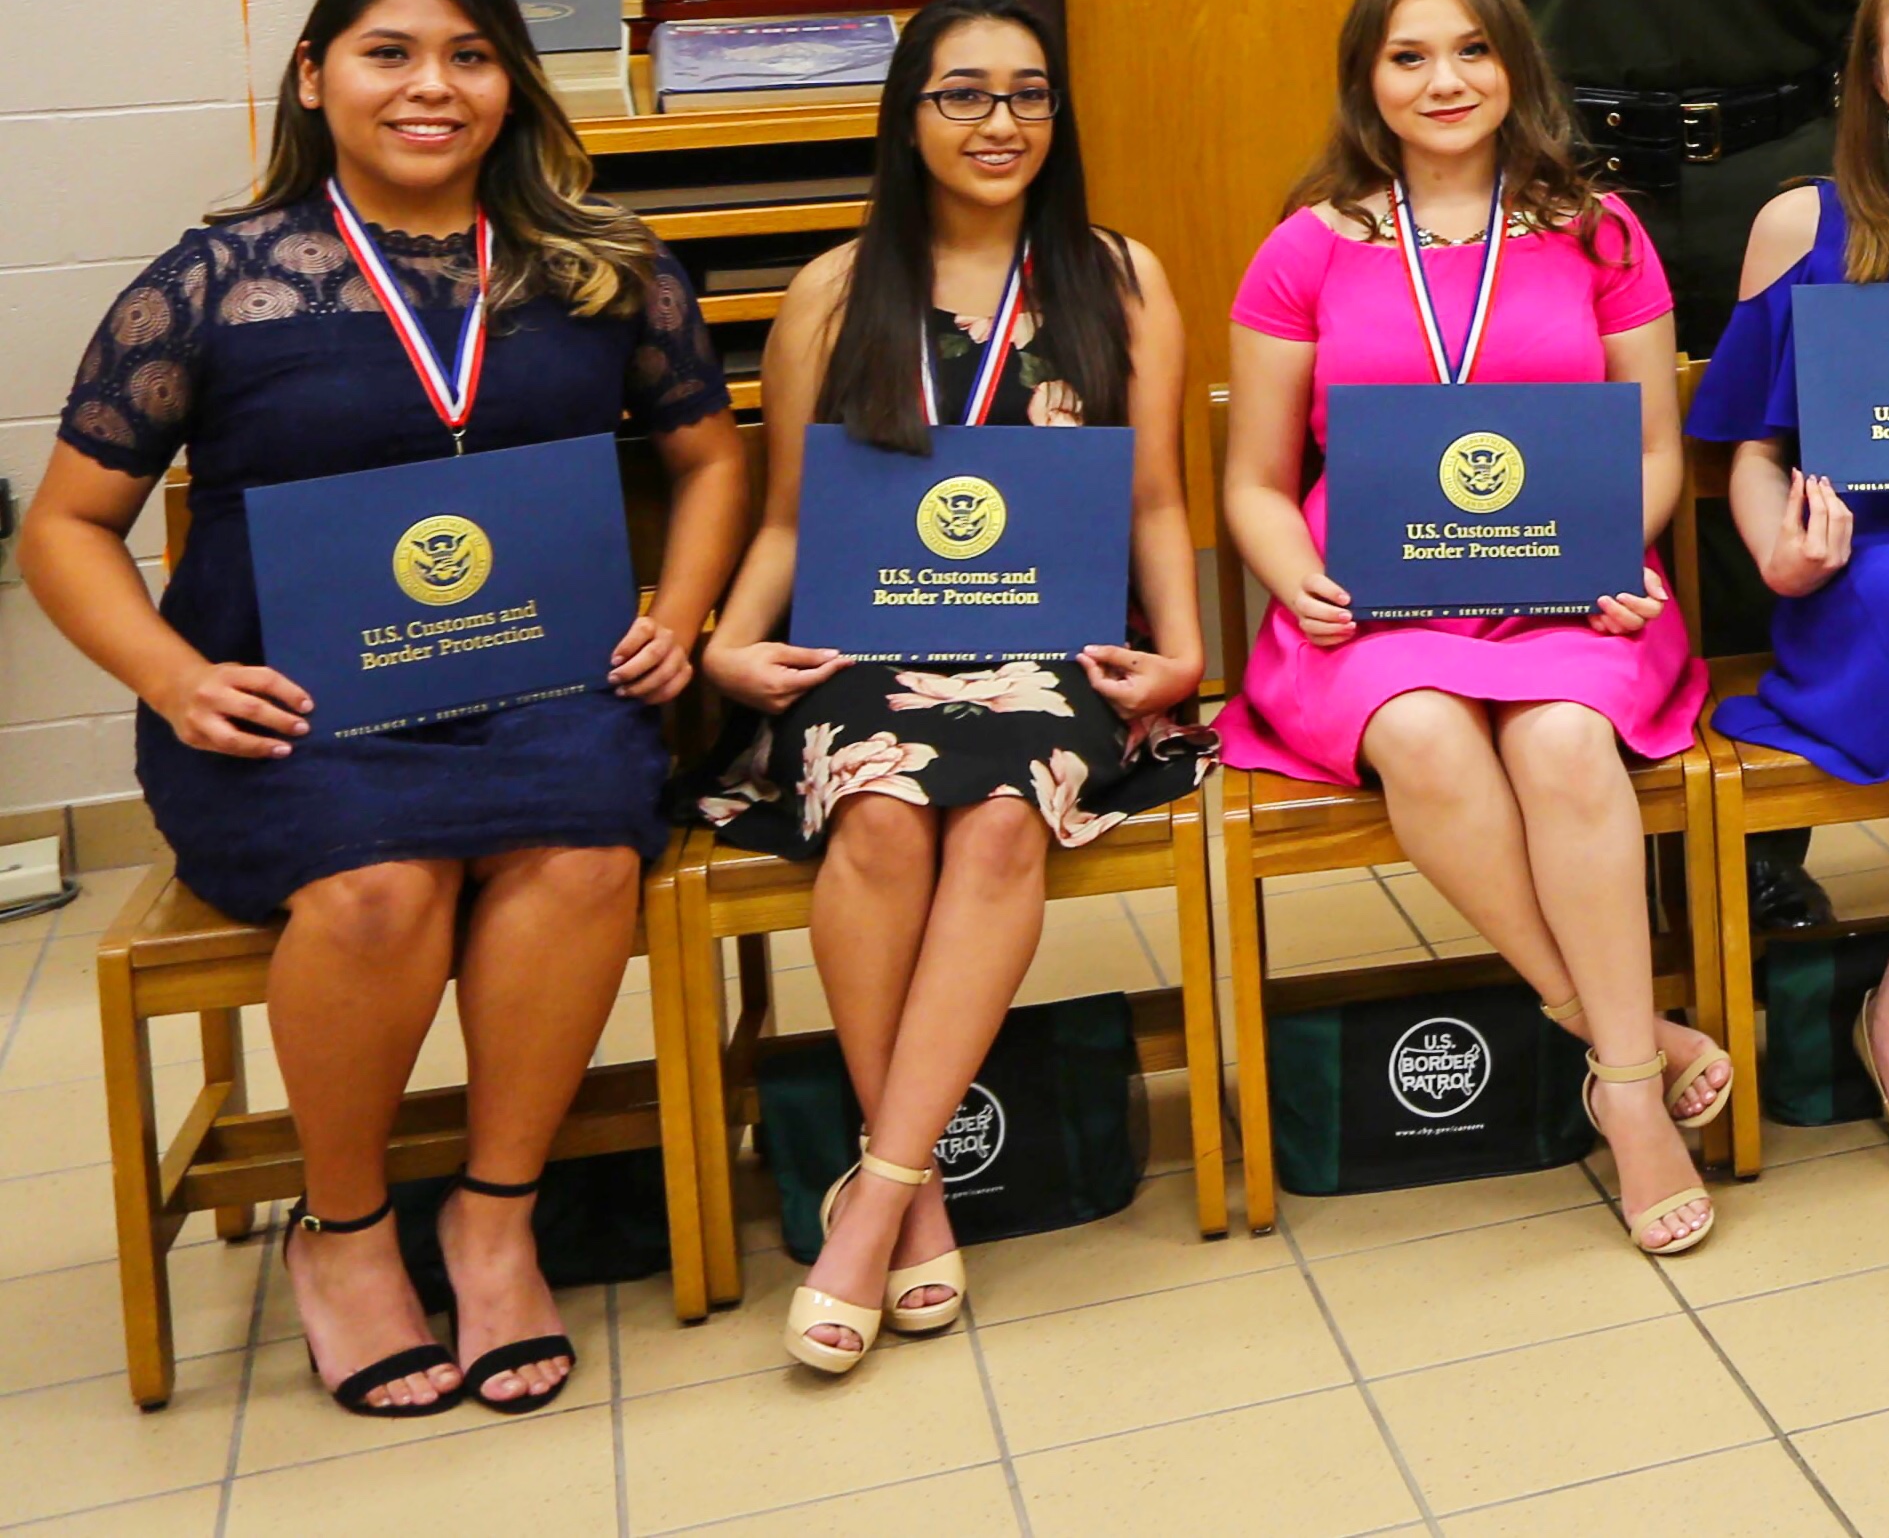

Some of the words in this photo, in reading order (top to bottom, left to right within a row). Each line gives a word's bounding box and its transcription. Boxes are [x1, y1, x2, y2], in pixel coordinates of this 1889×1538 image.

[1406, 524, 1440, 539] U.S.
[1444, 523, 1520, 540] Customs
[1524, 521, 1557, 537] and
[1402, 543, 1464, 560] Border
[1468, 541, 1561, 559] Protection
[878, 569, 914, 585] U.S.
[917, 568, 998, 585] Customs
[1001, 568, 1036, 585] and
[873, 589, 938, 606] Border
[942, 589, 1040, 605] Protection
[1371, 609, 1433, 618] VIGILANCE
[1458, 607, 1504, 616] SERVICE
[1529, 605, 1591, 614] INTEGRITY
[362, 625, 402, 647] U.S.
[407, 611, 496, 640] Customs
[500, 600, 538, 621] and
[360, 643, 434, 670] Border
[438, 622, 545, 656] Protection
[1424, 1034, 1456, 1050] U.S.
[1401, 1054, 1475, 1072] BORDER
[1402, 1075, 1475, 1092] PATROL
